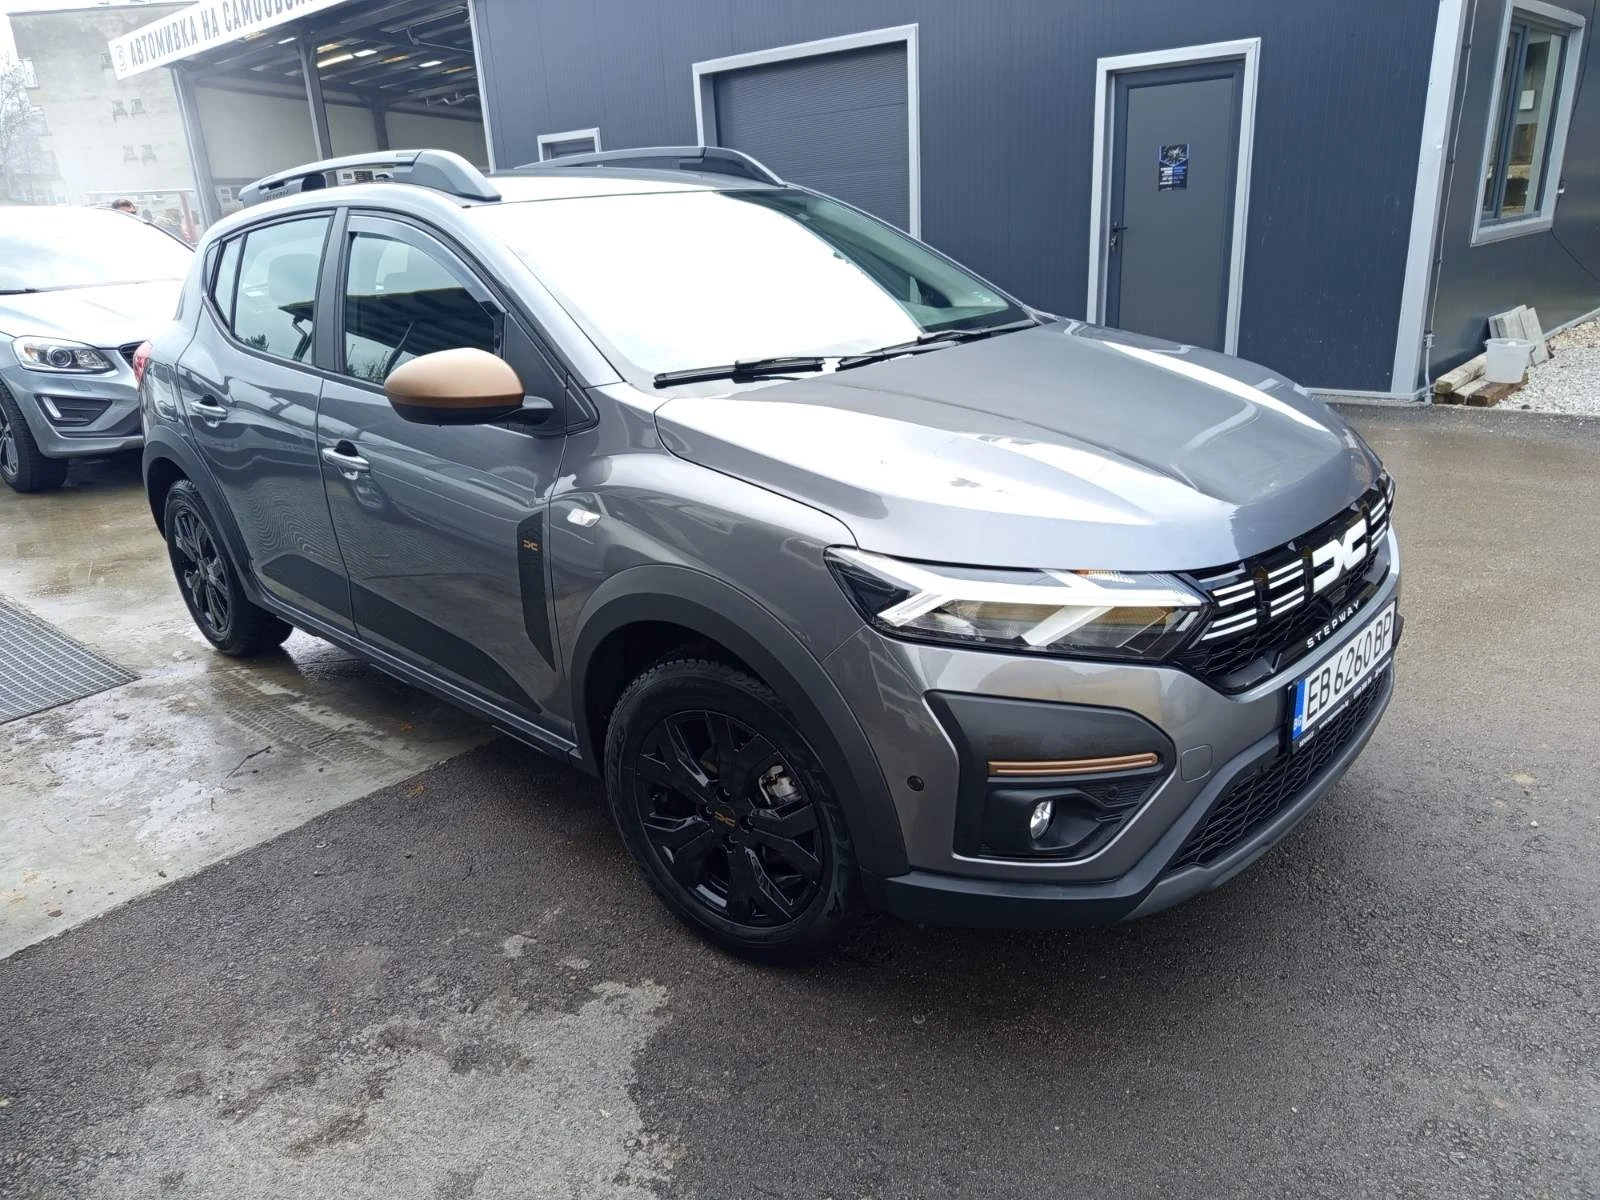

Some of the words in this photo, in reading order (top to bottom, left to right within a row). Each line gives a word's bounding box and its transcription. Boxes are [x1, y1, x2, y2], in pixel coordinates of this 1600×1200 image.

[130, 16, 198, 67] АВТОМИВКА
[201, 6, 220, 41] НА
[1307, 600, 1359, 649] STEPWAY
